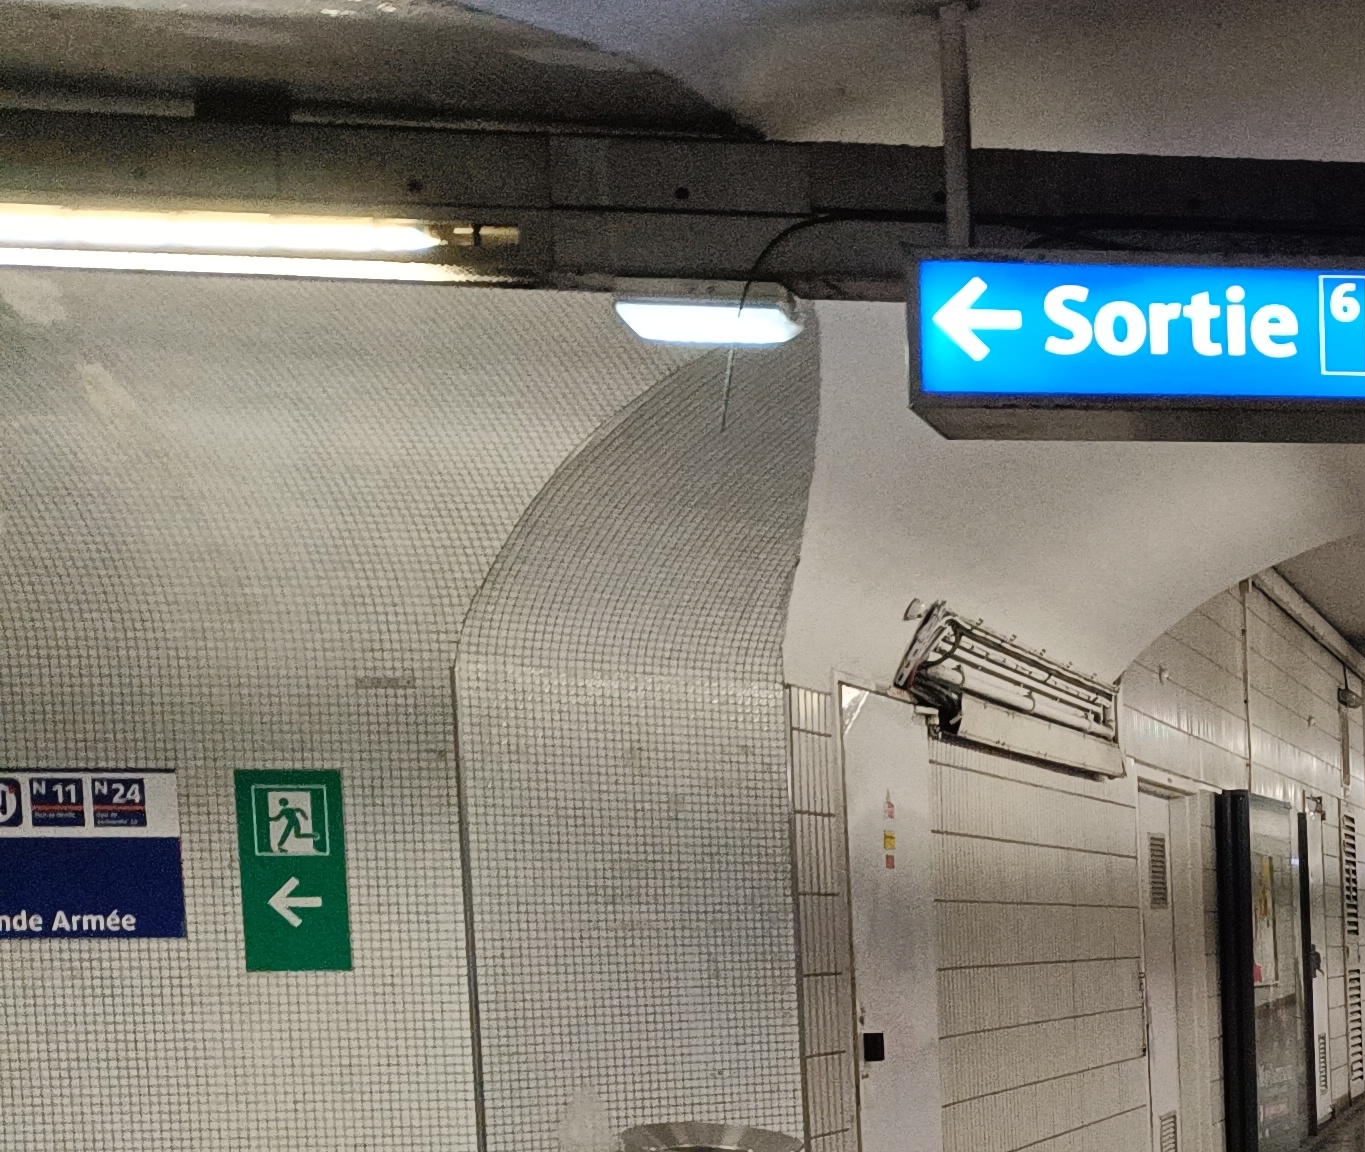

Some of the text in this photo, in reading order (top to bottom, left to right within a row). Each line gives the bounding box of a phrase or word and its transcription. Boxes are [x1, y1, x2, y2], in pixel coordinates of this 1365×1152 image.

[1043, 284, 1298, 358] Sortie
[1330, 282, 1360, 322] 6
[51, 909, 137, 932] Armée
